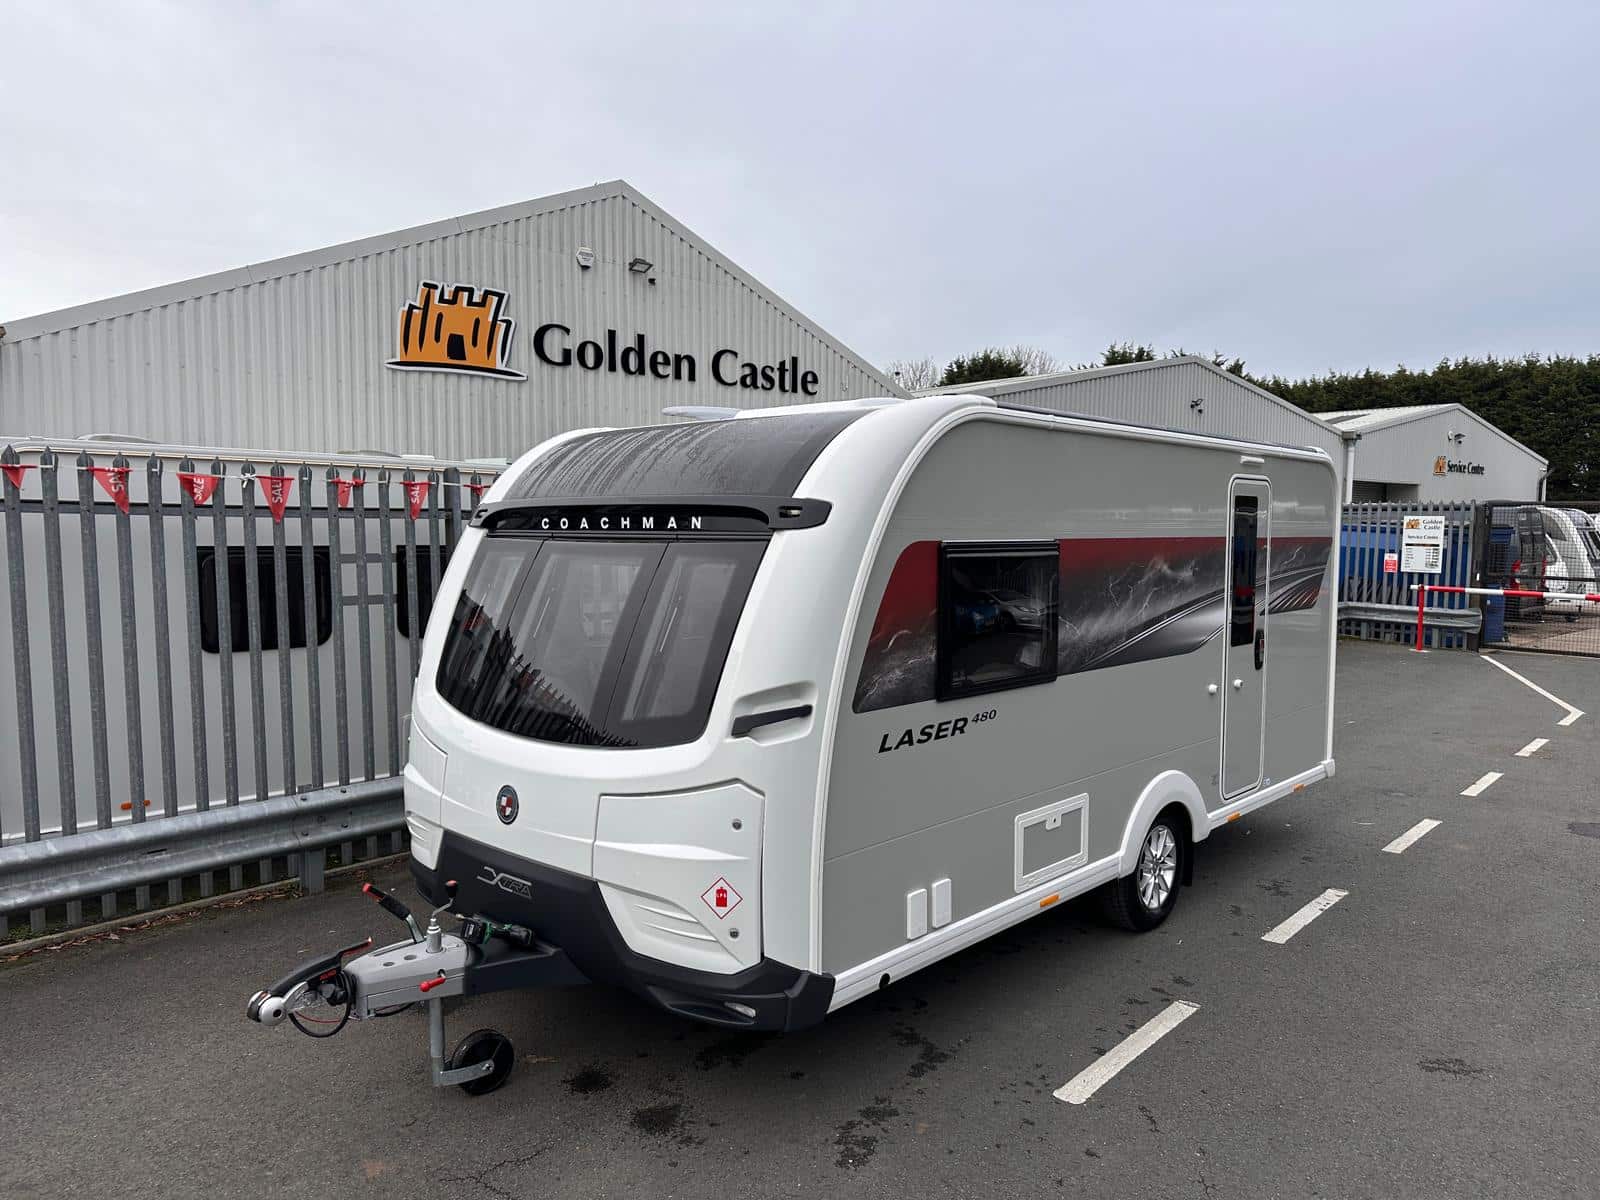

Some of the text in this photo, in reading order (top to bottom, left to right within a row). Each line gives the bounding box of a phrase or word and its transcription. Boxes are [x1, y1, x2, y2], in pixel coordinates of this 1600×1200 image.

[532, 323, 819, 396] Golden Castle
[1447, 460, 1485, 475] Service Centre
[271, 479, 284, 504] SAL
[541, 516, 703, 530] COACHMAN
[878, 709, 997, 754] LASER 480
